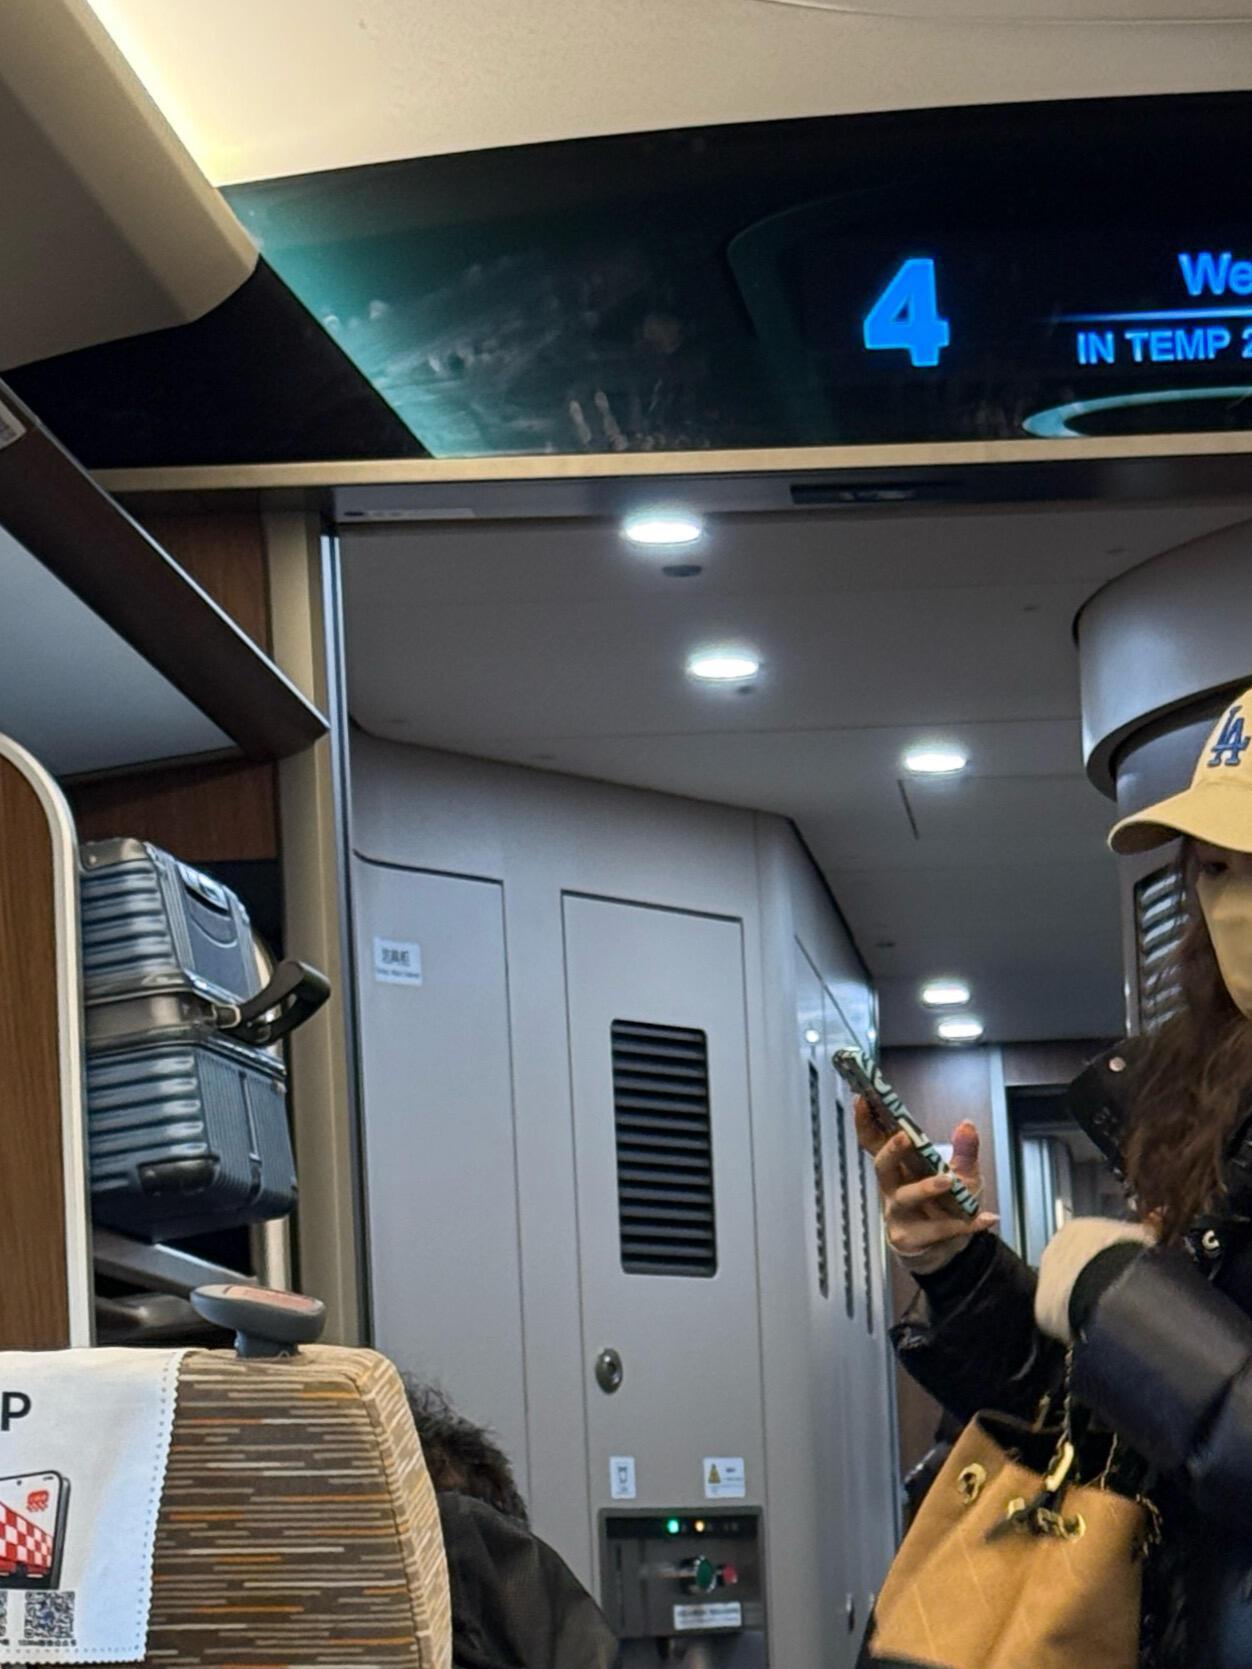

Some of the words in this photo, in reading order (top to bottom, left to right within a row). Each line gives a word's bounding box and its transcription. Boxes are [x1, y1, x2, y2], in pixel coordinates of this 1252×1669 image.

[863, 257, 950, 367] 4
[1077, 330, 1115, 364] IN
[1124, 325, 1231, 363] TEMP
